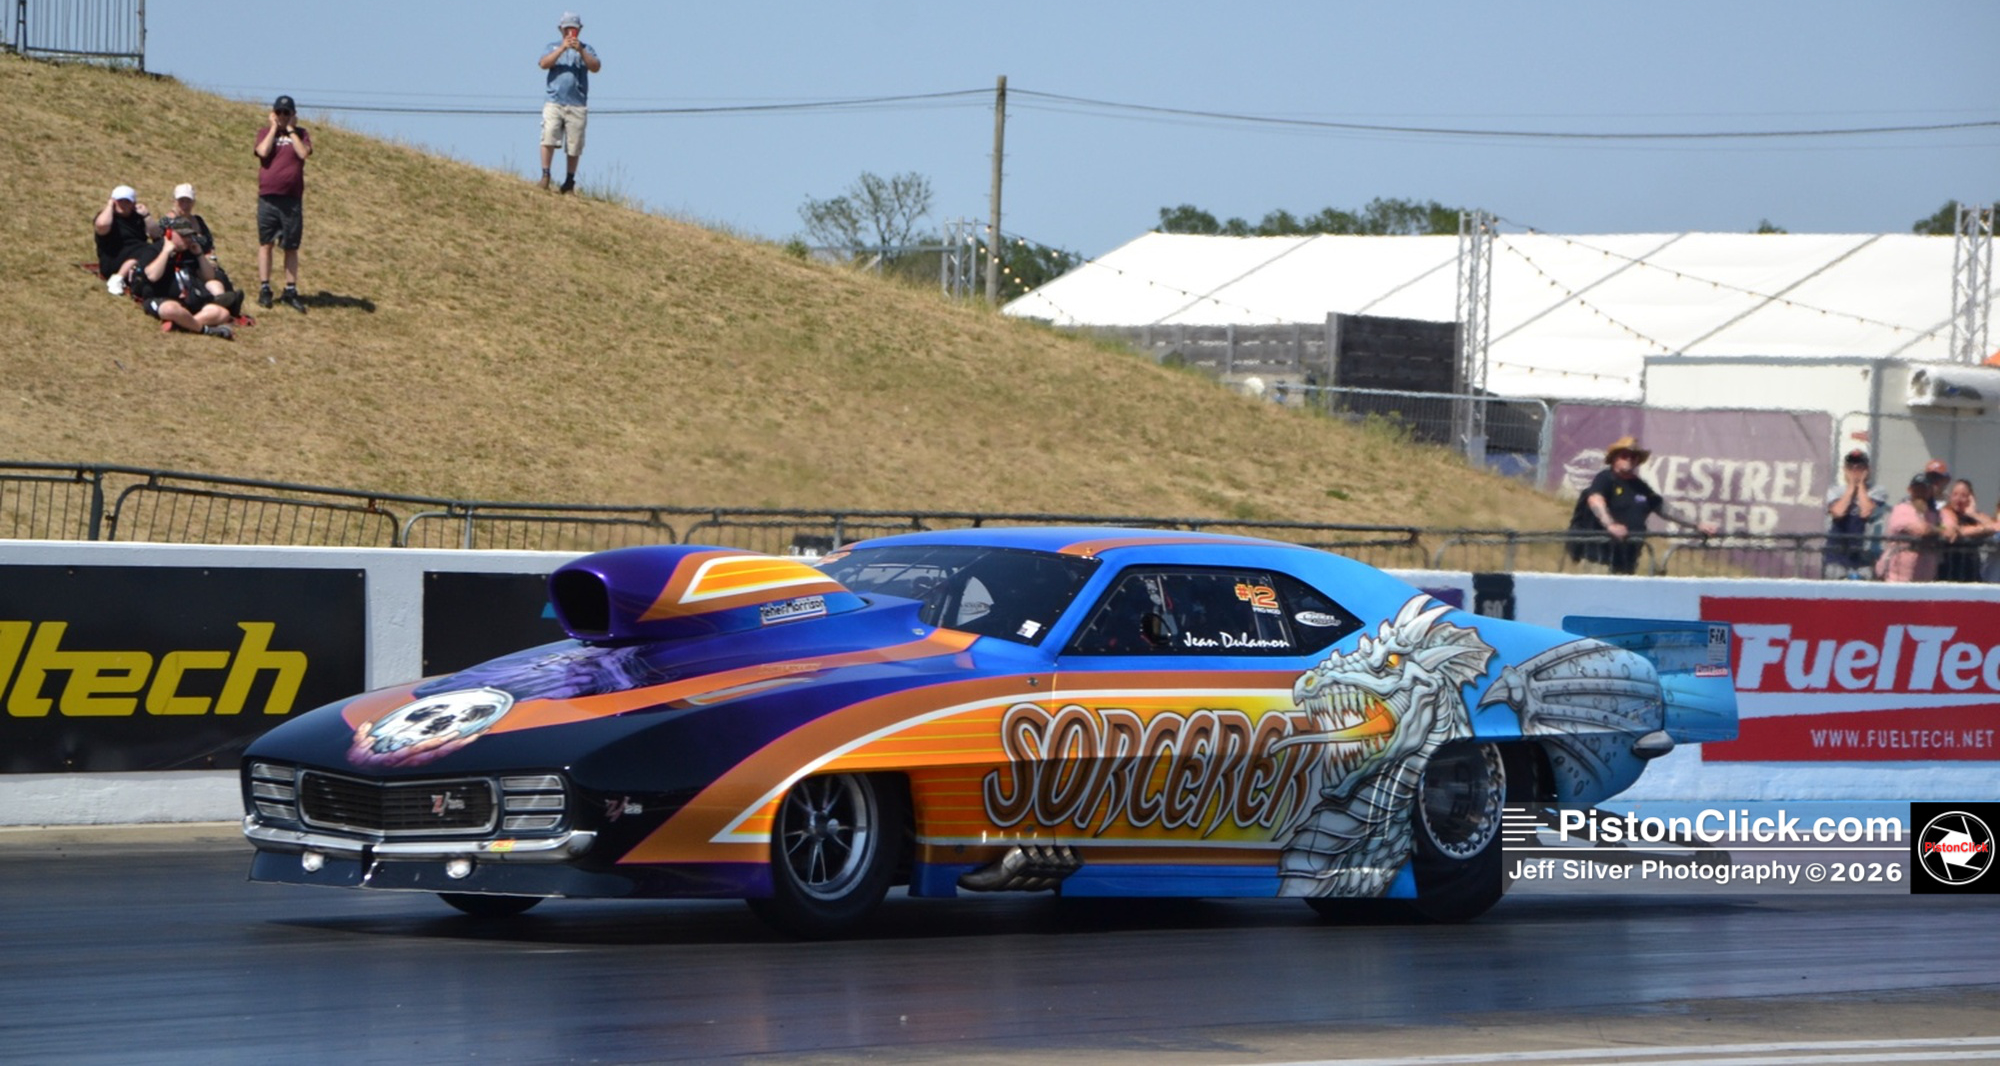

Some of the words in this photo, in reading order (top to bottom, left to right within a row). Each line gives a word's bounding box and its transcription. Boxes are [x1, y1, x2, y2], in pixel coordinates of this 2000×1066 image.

[1638, 454, 1823, 507] KESTREL
[1234, 583, 1279, 609] #12
[1183, 631, 1218, 647] Jean
[1709, 628, 1727, 644] FIA
[1811, 729, 1995, 748] WWW.FUELTECH.NET
[983, 703, 1326, 840] SORCERER
